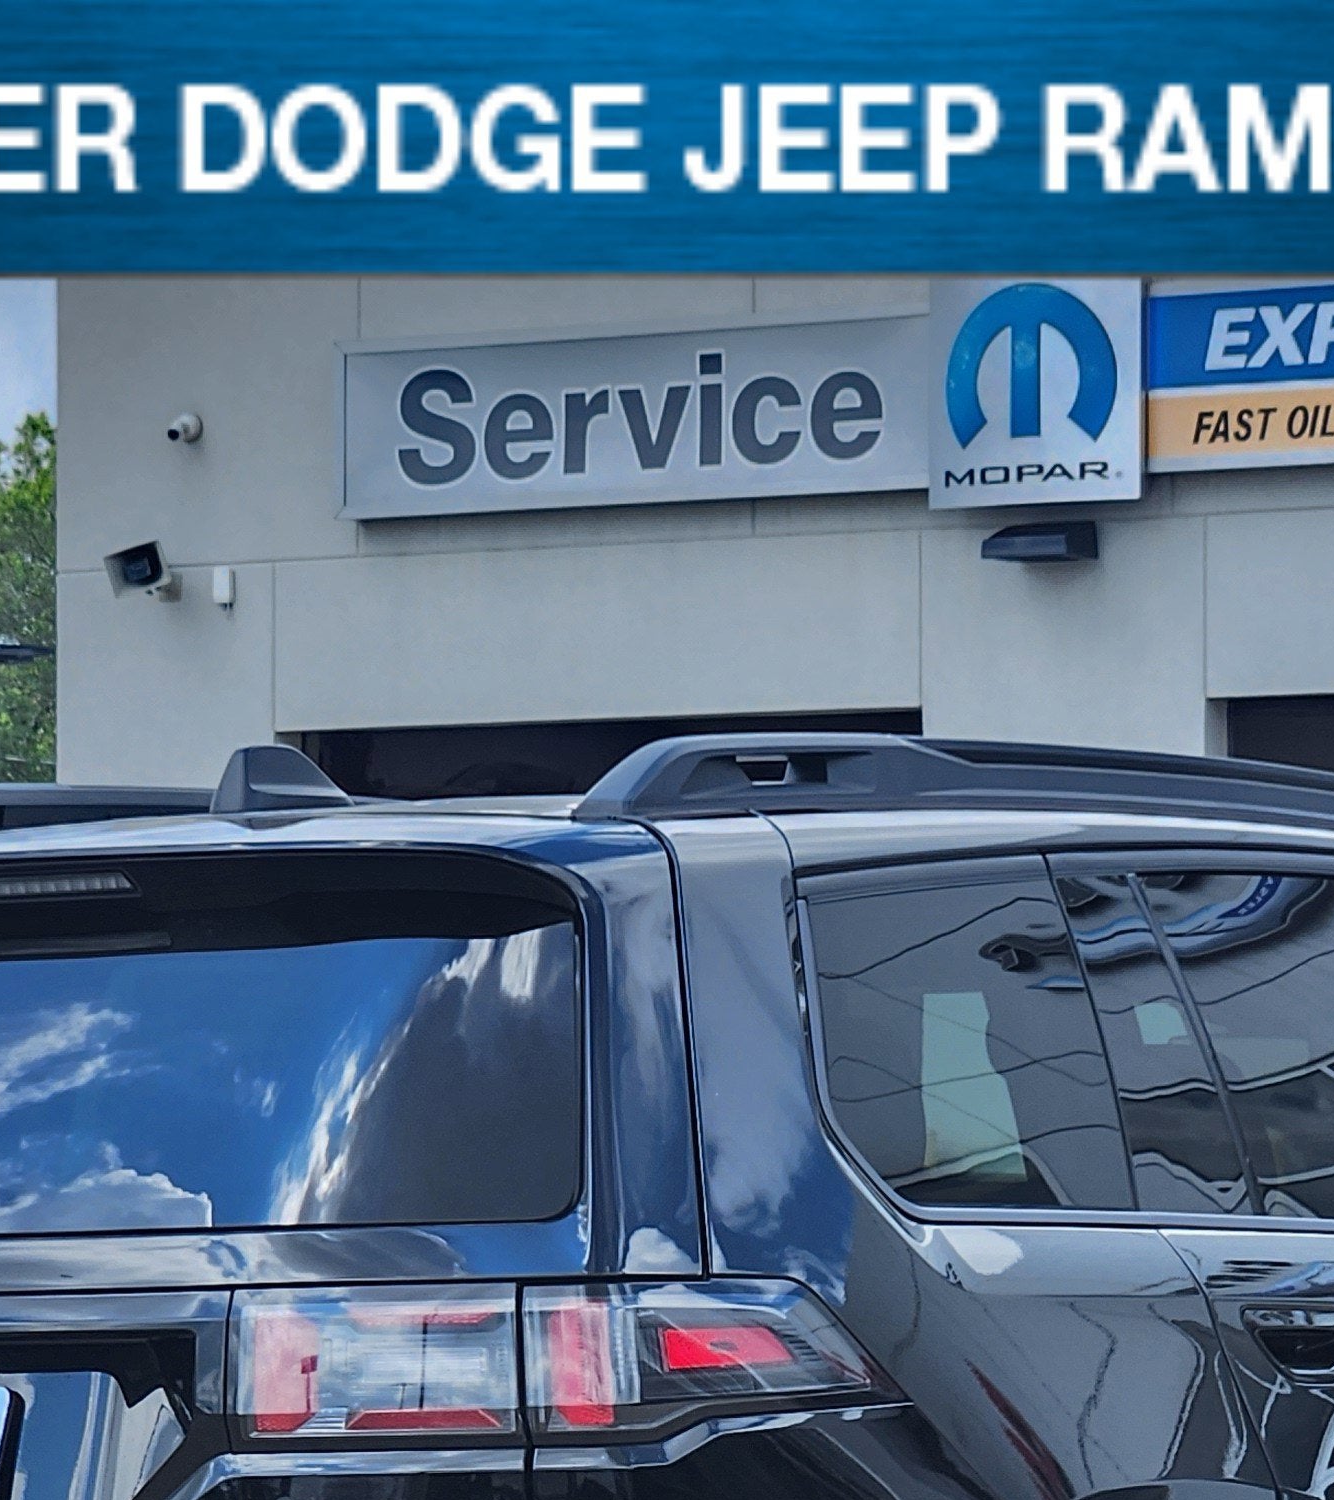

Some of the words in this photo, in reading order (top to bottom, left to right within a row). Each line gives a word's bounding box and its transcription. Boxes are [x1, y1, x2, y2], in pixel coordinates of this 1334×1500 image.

[397, 351, 885, 487] Service
[1192, 407, 1277, 446] FAST
[943, 461, 1111, 488] MOPAR
